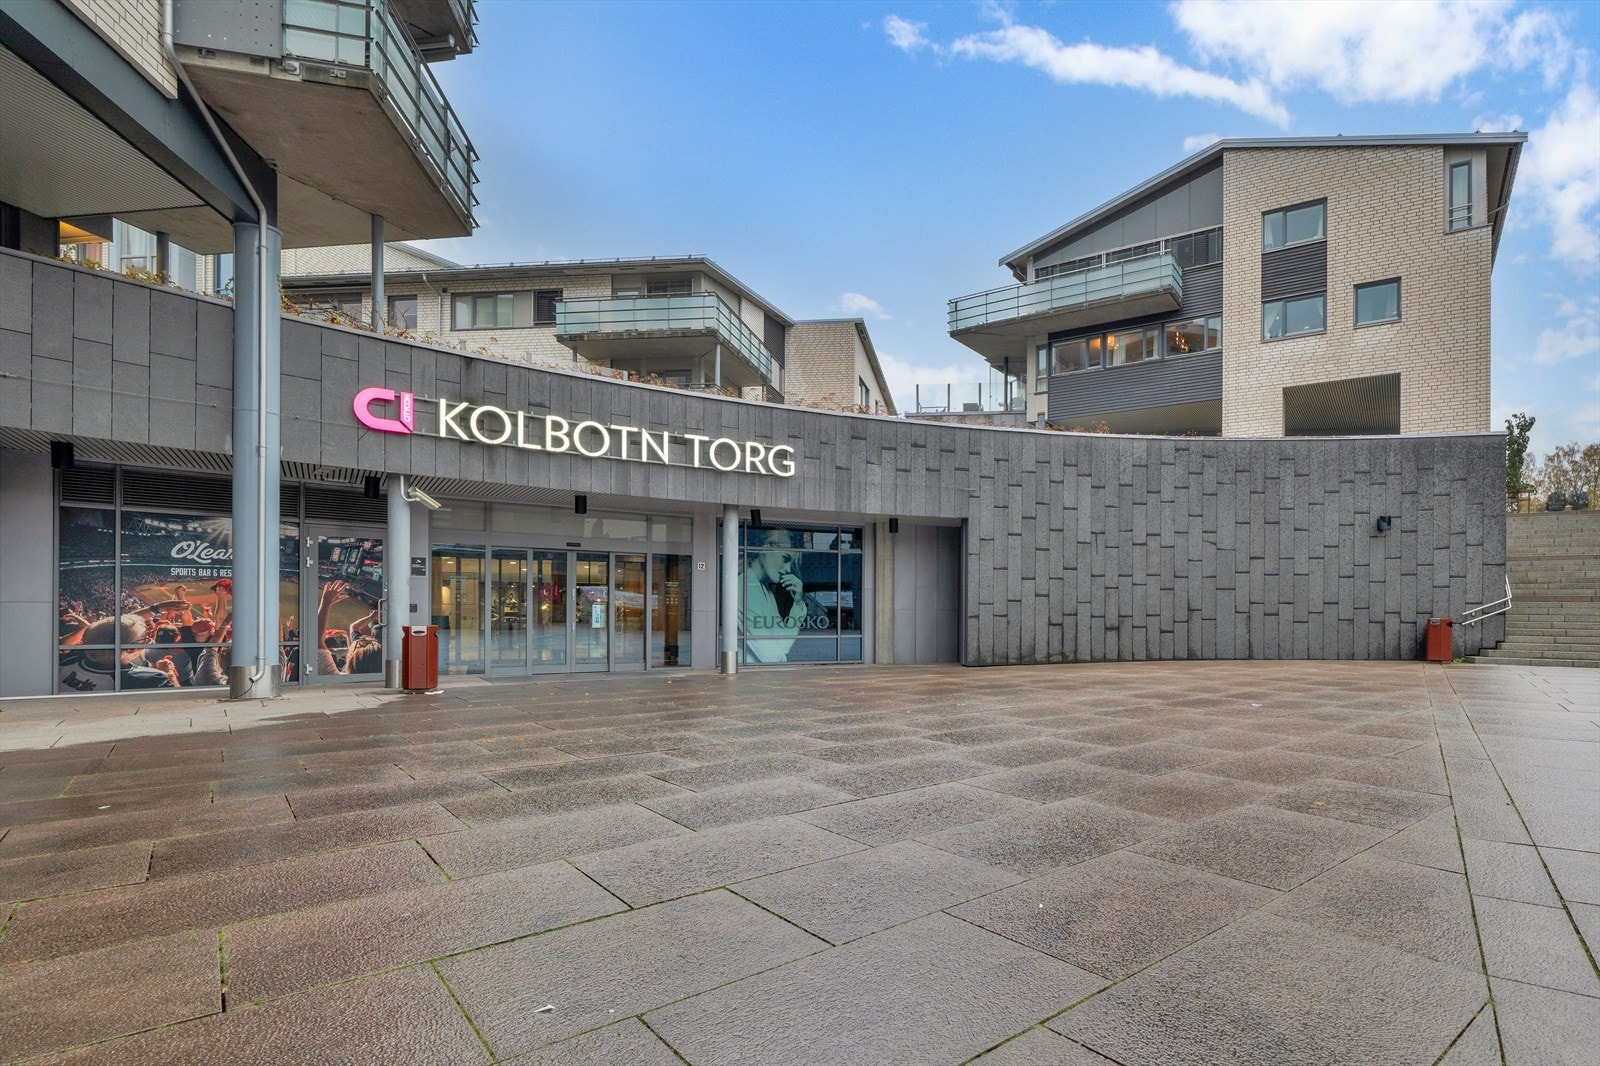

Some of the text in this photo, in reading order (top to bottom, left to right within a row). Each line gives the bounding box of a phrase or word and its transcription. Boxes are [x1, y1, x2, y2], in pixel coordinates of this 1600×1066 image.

[439, 398, 796, 477] KOLBOTN TORG
[170, 567, 197, 576] SPORTS
[198, 568, 211, 577] BAR
[219, 569, 232, 577] RES
[753, 615, 830, 629] EUROSKO
